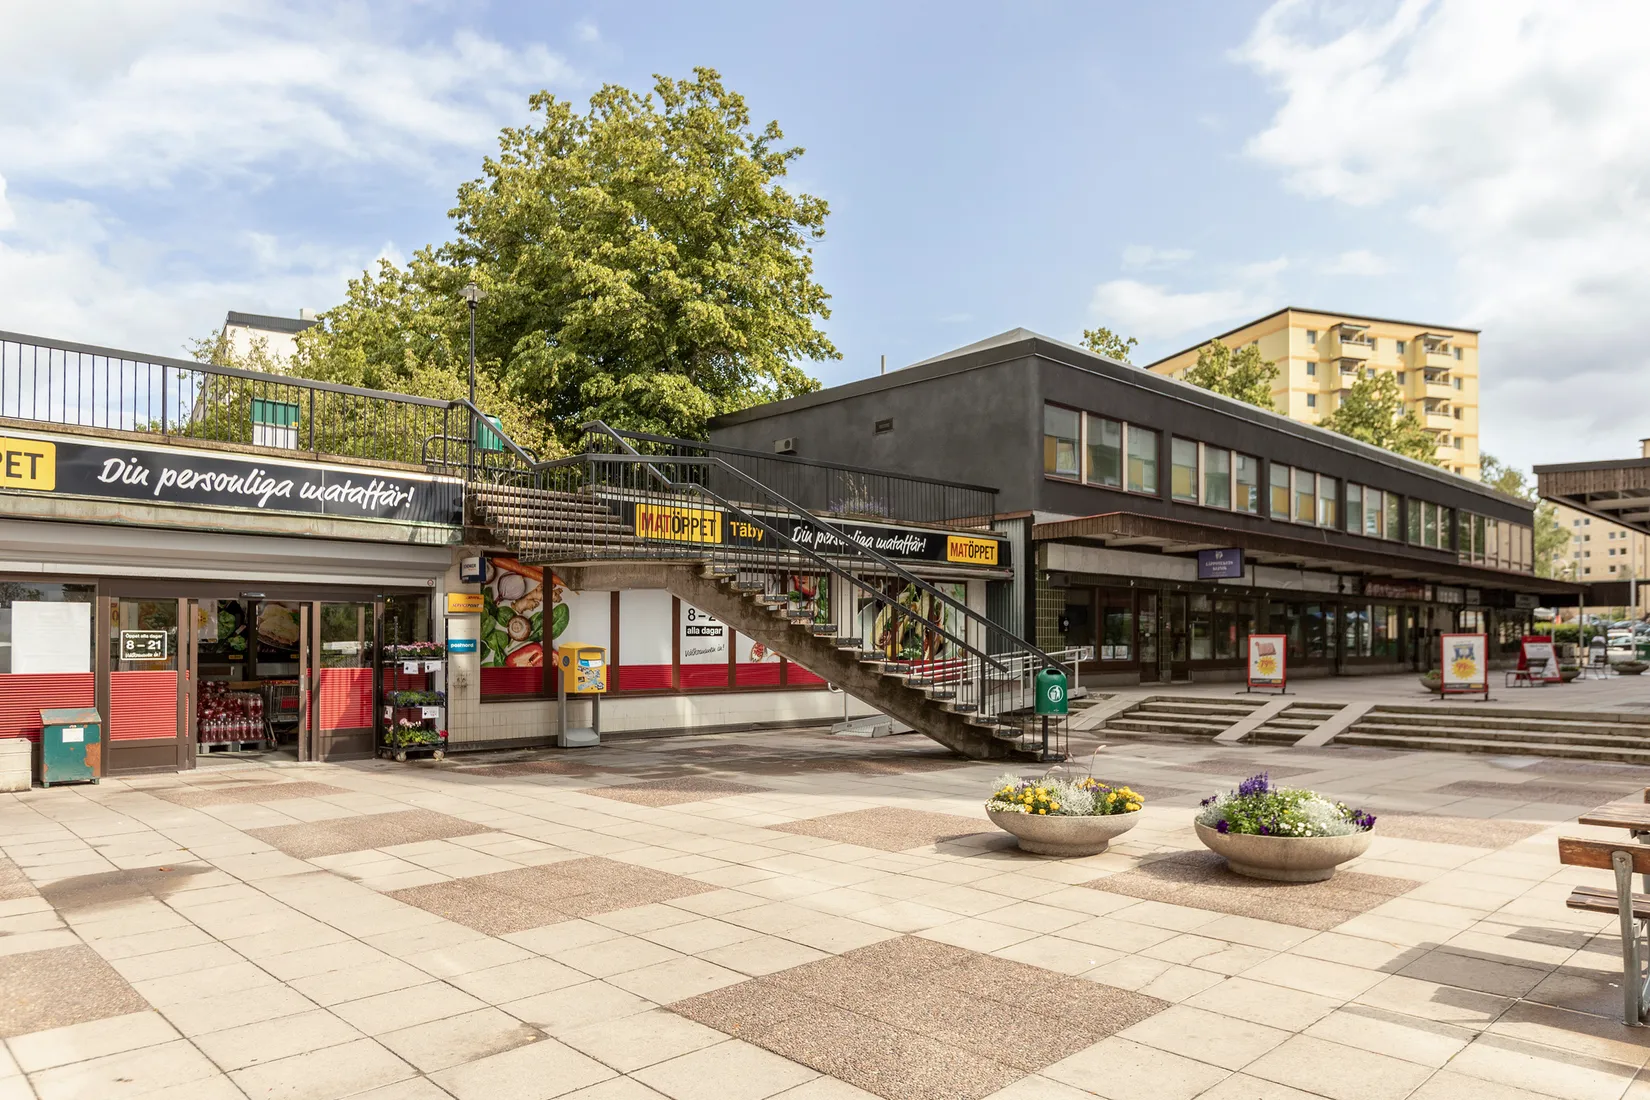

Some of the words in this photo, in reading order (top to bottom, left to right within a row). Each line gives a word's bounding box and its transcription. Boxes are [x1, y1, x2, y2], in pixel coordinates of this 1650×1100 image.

[97, 457, 150, 486] Din
[153, 466, 294, 507] personliga
[299, 477, 415, 510] mataffär!
[640, 511, 717, 537] MATÖPPET
[730, 521, 764, 541] Täby
[791, 525, 813, 544] Din
[875, 534, 927, 555] mataffär!
[950, 540, 995, 560] MATÖPPET
[688, 608, 696, 621] 8
[687, 627, 700, 635] alla
[701, 627, 722, 636] dagar
[126, 640, 135, 649] 8
[147, 640, 161, 649] 21
